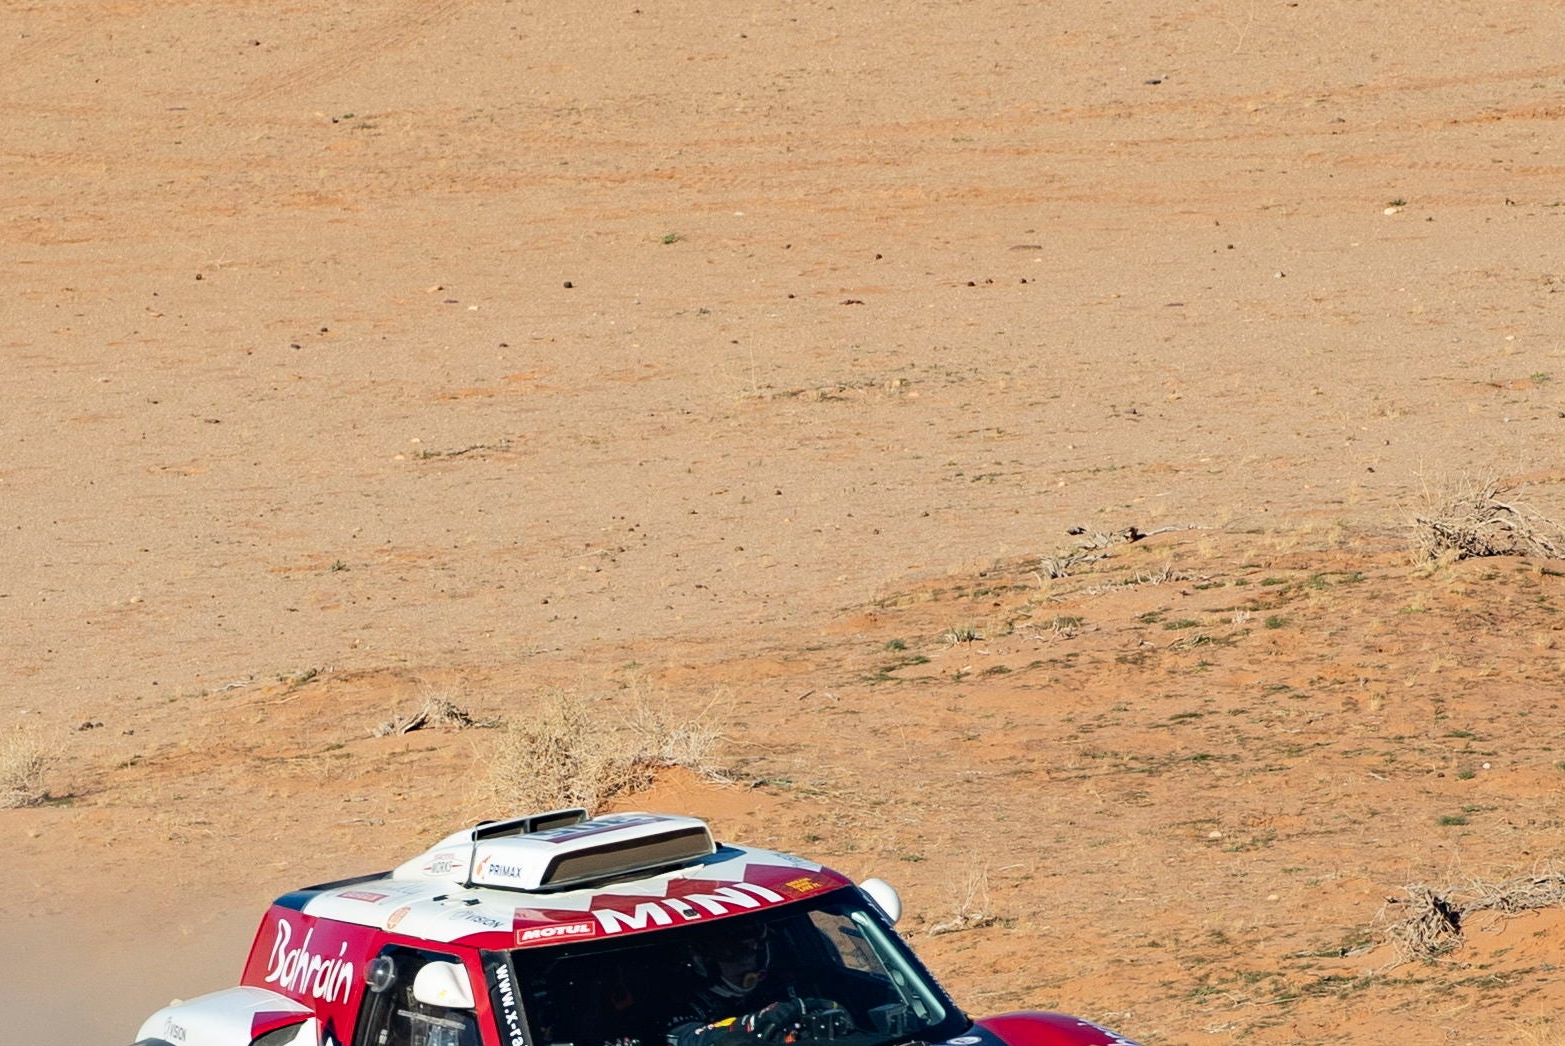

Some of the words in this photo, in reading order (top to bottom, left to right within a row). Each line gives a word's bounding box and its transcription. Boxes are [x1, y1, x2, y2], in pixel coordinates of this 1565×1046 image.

[488, 863, 524, 879] PRIMAX
[591, 882, 785, 934] MINI
[522, 924, 590, 941] MOTUL
[265, 918, 354, 1005] Bahrain
